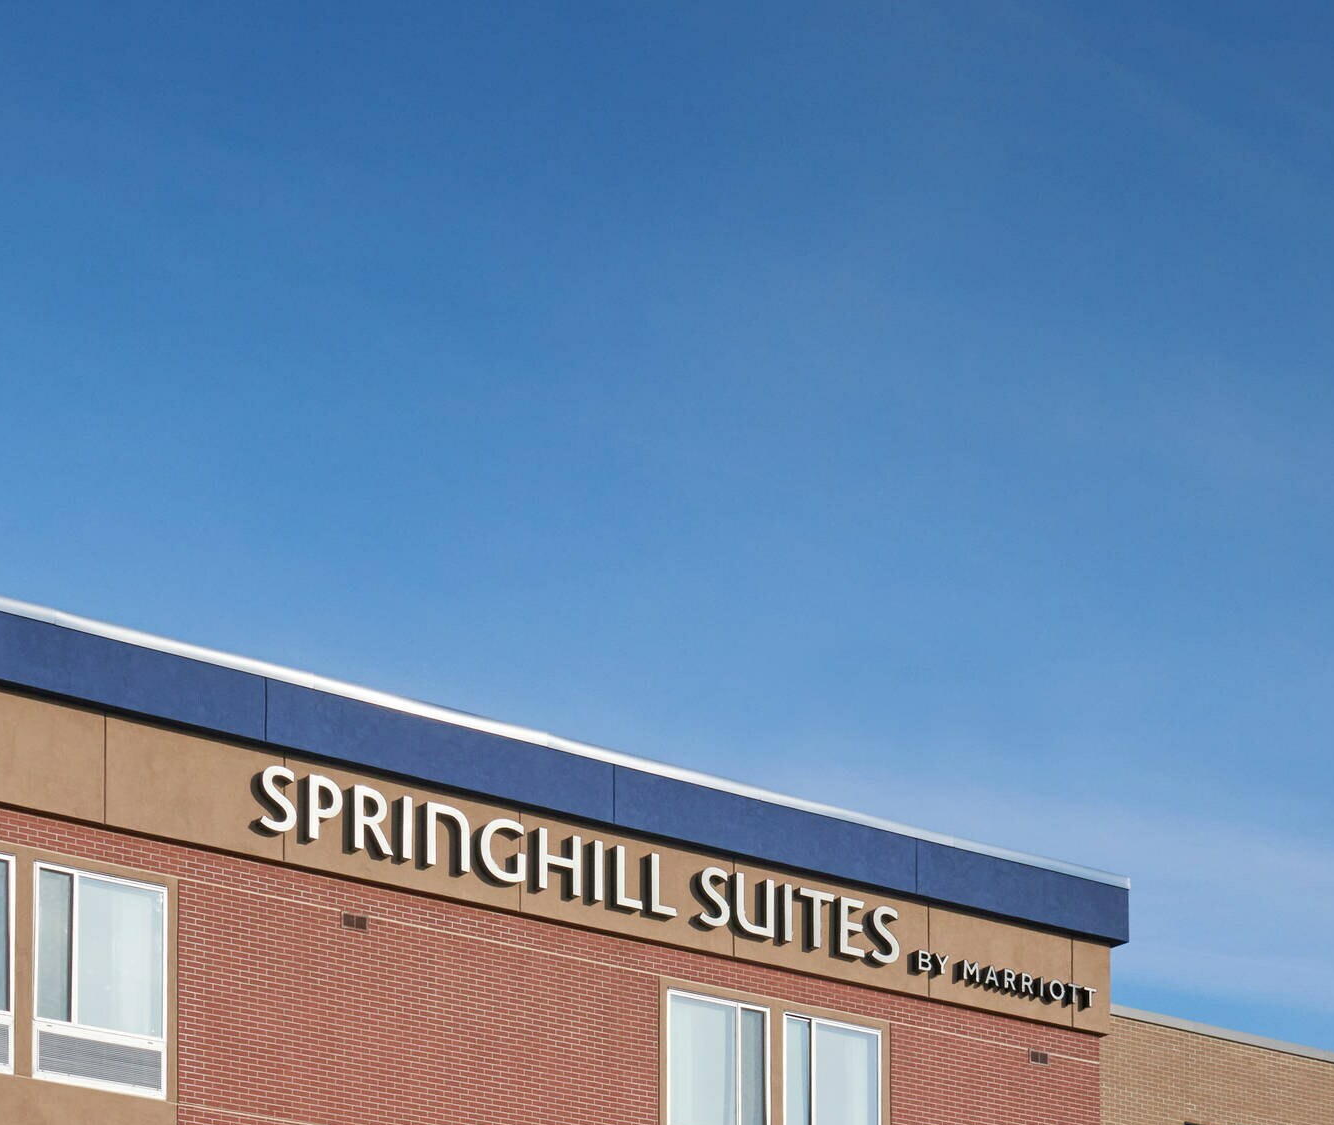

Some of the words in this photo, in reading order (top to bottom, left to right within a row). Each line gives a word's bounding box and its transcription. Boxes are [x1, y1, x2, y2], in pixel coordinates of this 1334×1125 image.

[257, 764, 678, 918] SPRINGHILL
[697, 866, 901, 965] SUITES
[917, 949, 950, 975] BY
[962, 959, 1098, 1009] MARRIOTT
